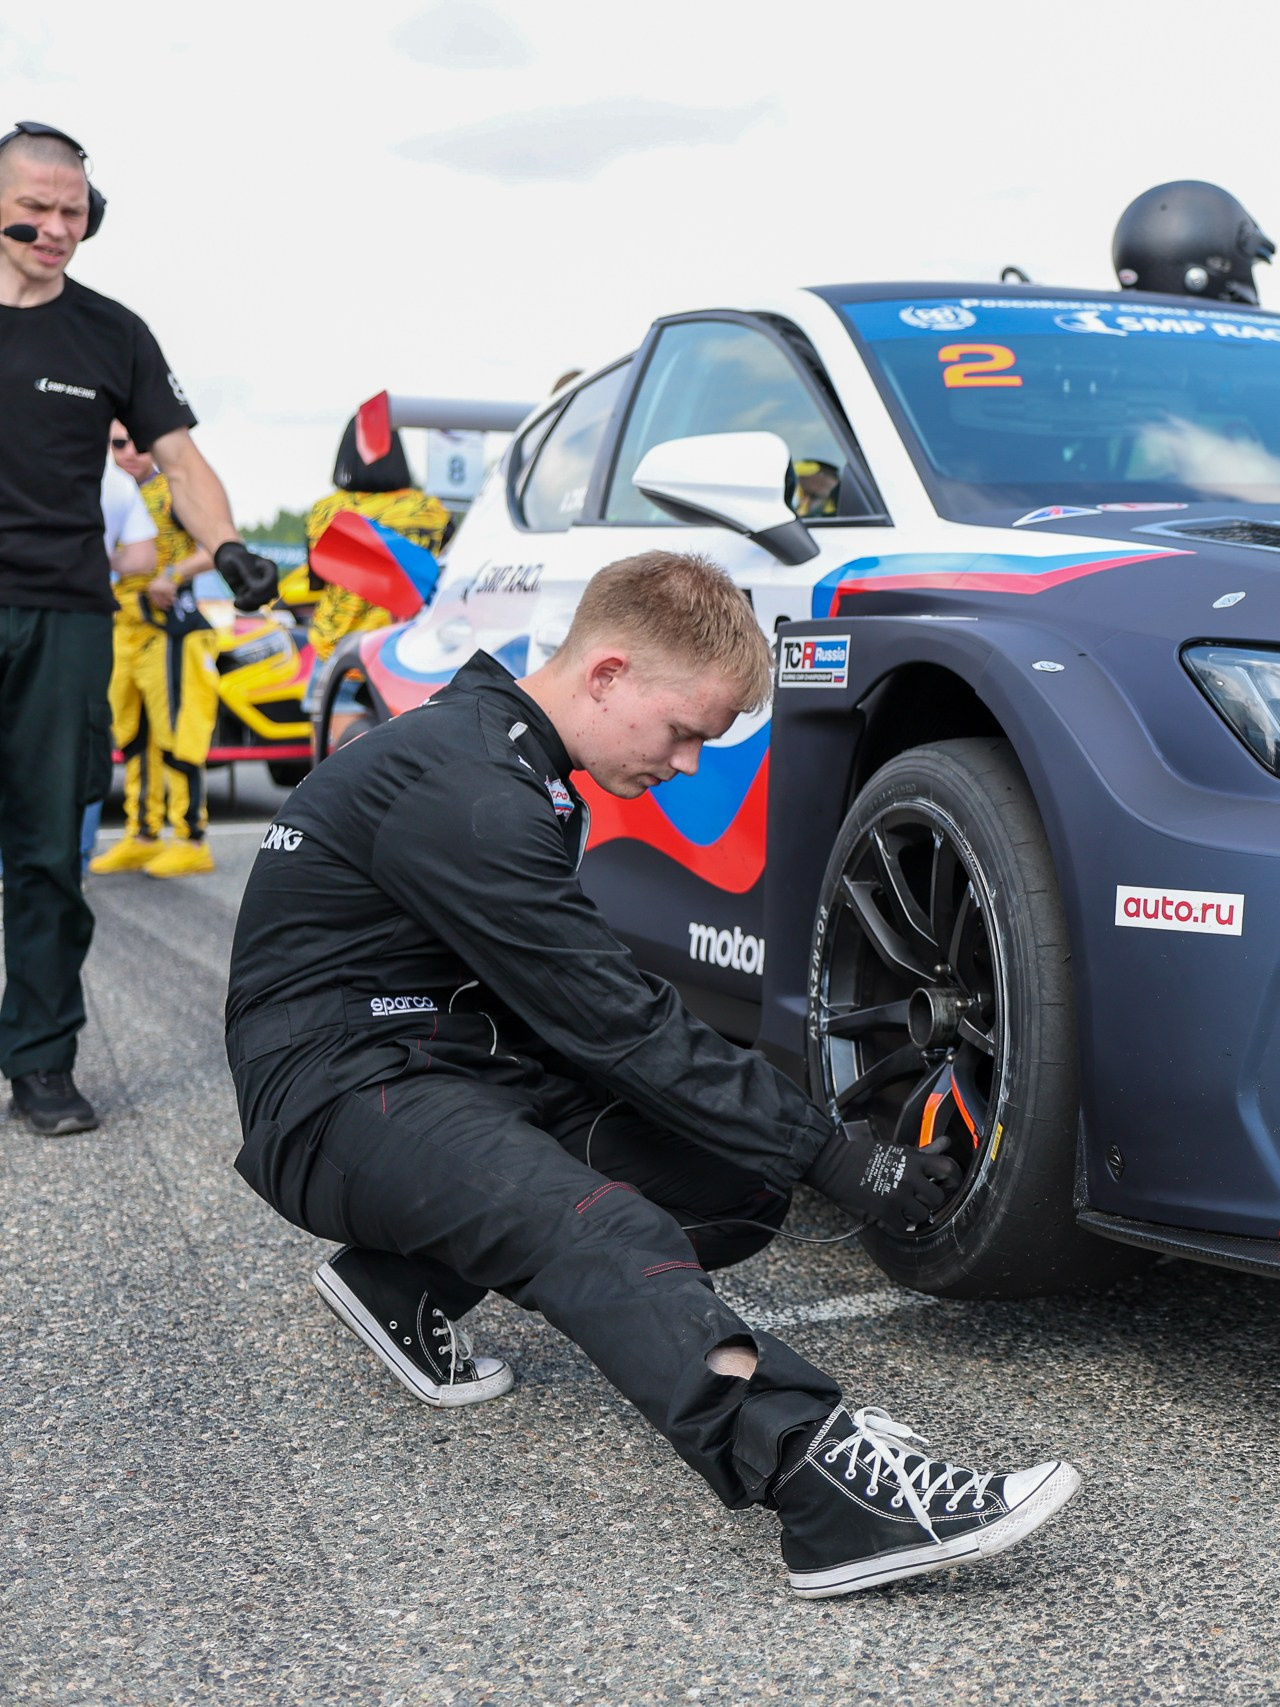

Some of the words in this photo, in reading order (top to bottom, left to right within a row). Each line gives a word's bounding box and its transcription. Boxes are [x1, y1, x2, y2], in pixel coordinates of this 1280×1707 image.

[1114, 315, 1206, 335] SMP
[938, 343, 1023, 388] 2
[784, 641, 817, 670] TCR
[814, 646, 846, 662] Russia
[1123, 896, 1235, 926] auto.ru
[371, 996, 435, 1016] sparco
